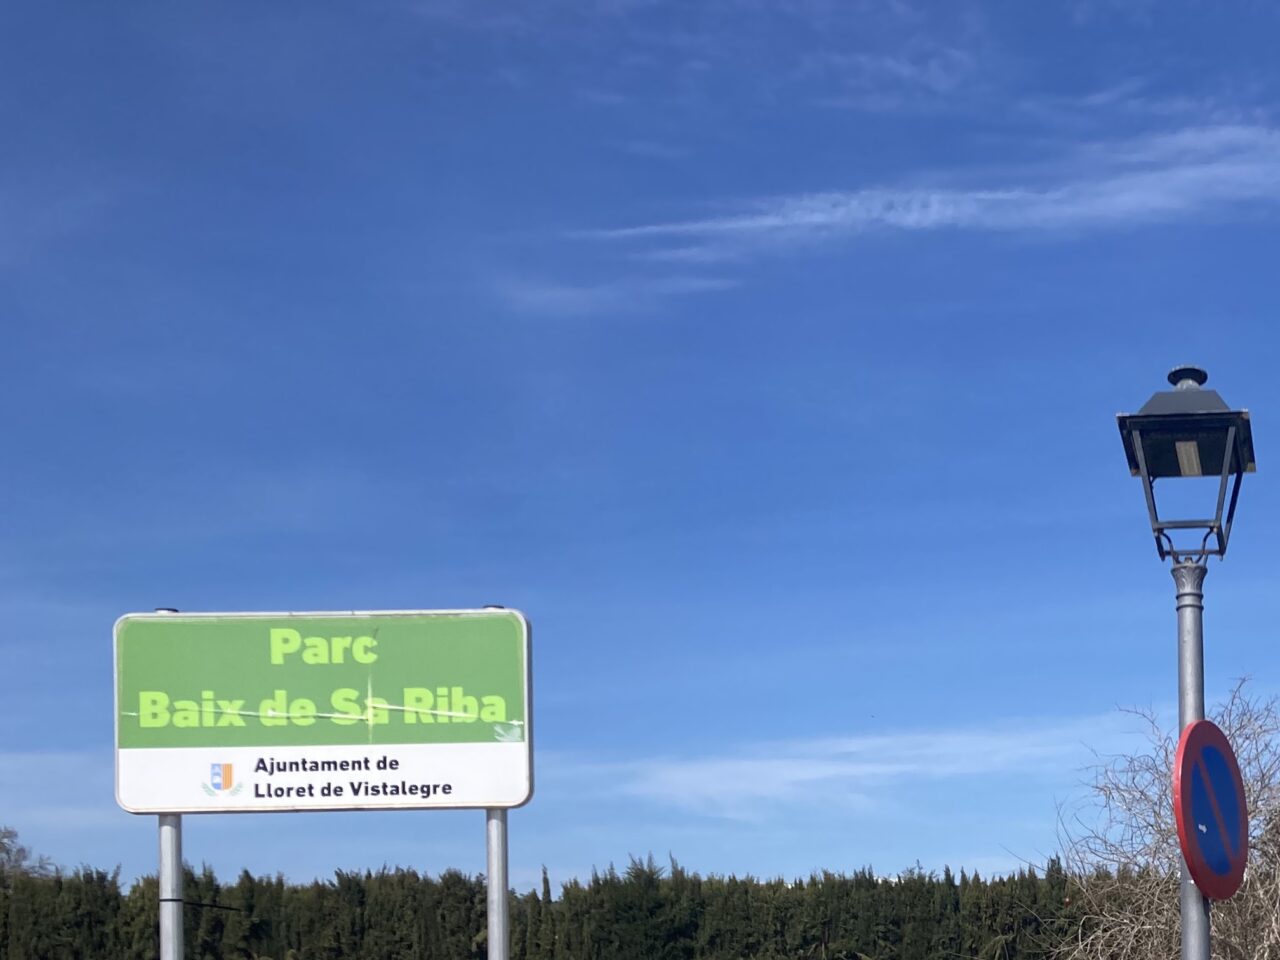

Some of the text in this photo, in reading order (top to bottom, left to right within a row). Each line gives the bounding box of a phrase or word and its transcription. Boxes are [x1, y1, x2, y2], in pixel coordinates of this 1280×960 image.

[270, 628, 378, 665] Parc
[139, 687, 506, 727] Baix de Sa Riba
[255, 757, 399, 776] Ajuntament de
[255, 781, 452, 799] Lloret de Vistalegre
